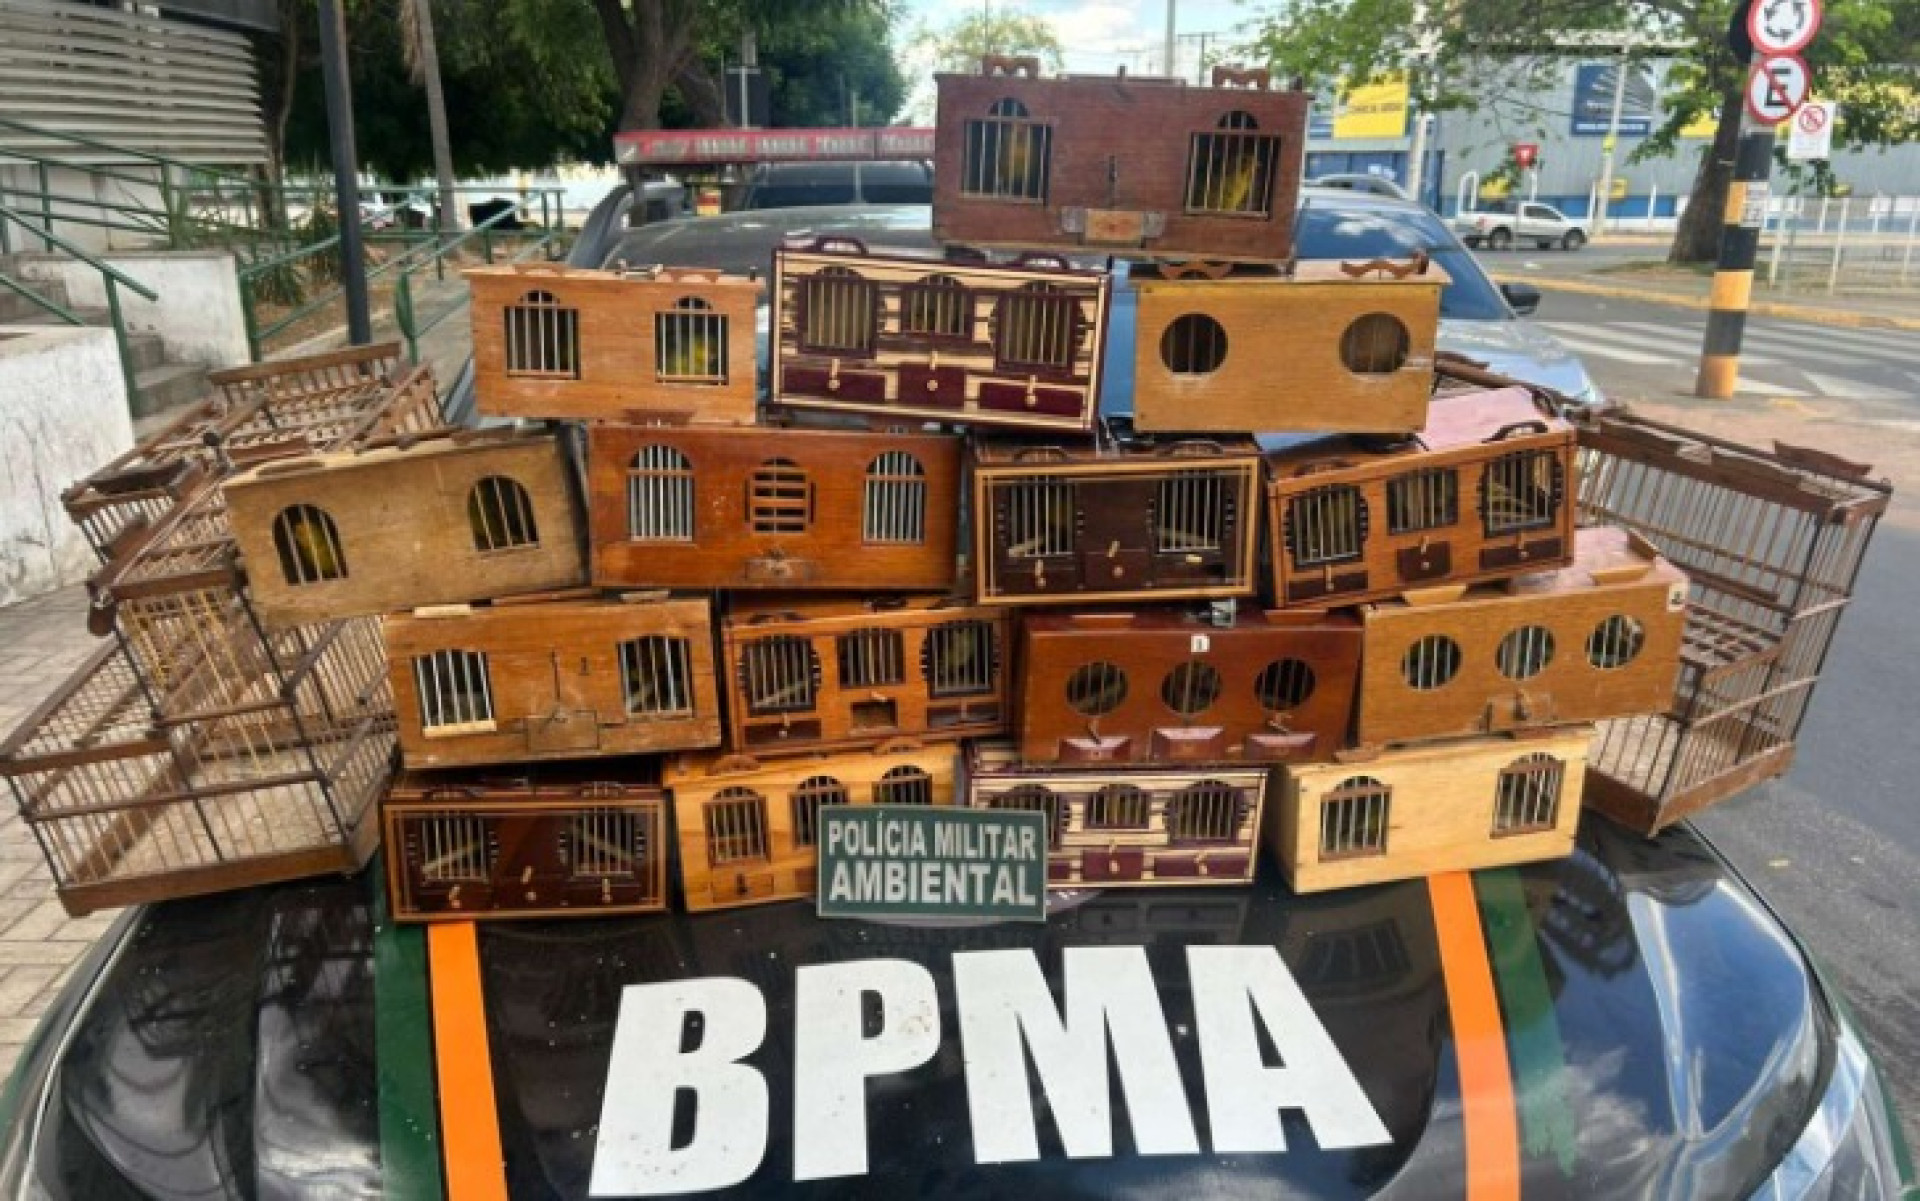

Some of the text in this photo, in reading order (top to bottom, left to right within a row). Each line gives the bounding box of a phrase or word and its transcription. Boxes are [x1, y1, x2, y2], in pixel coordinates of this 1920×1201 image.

[1764, 67, 1792, 107] E
[828, 810, 1036, 861] POLÍCIA MILITAR
[828, 860, 1036, 906] AMBIENTAL
[588, 944, 1395, 1197] BPMA
